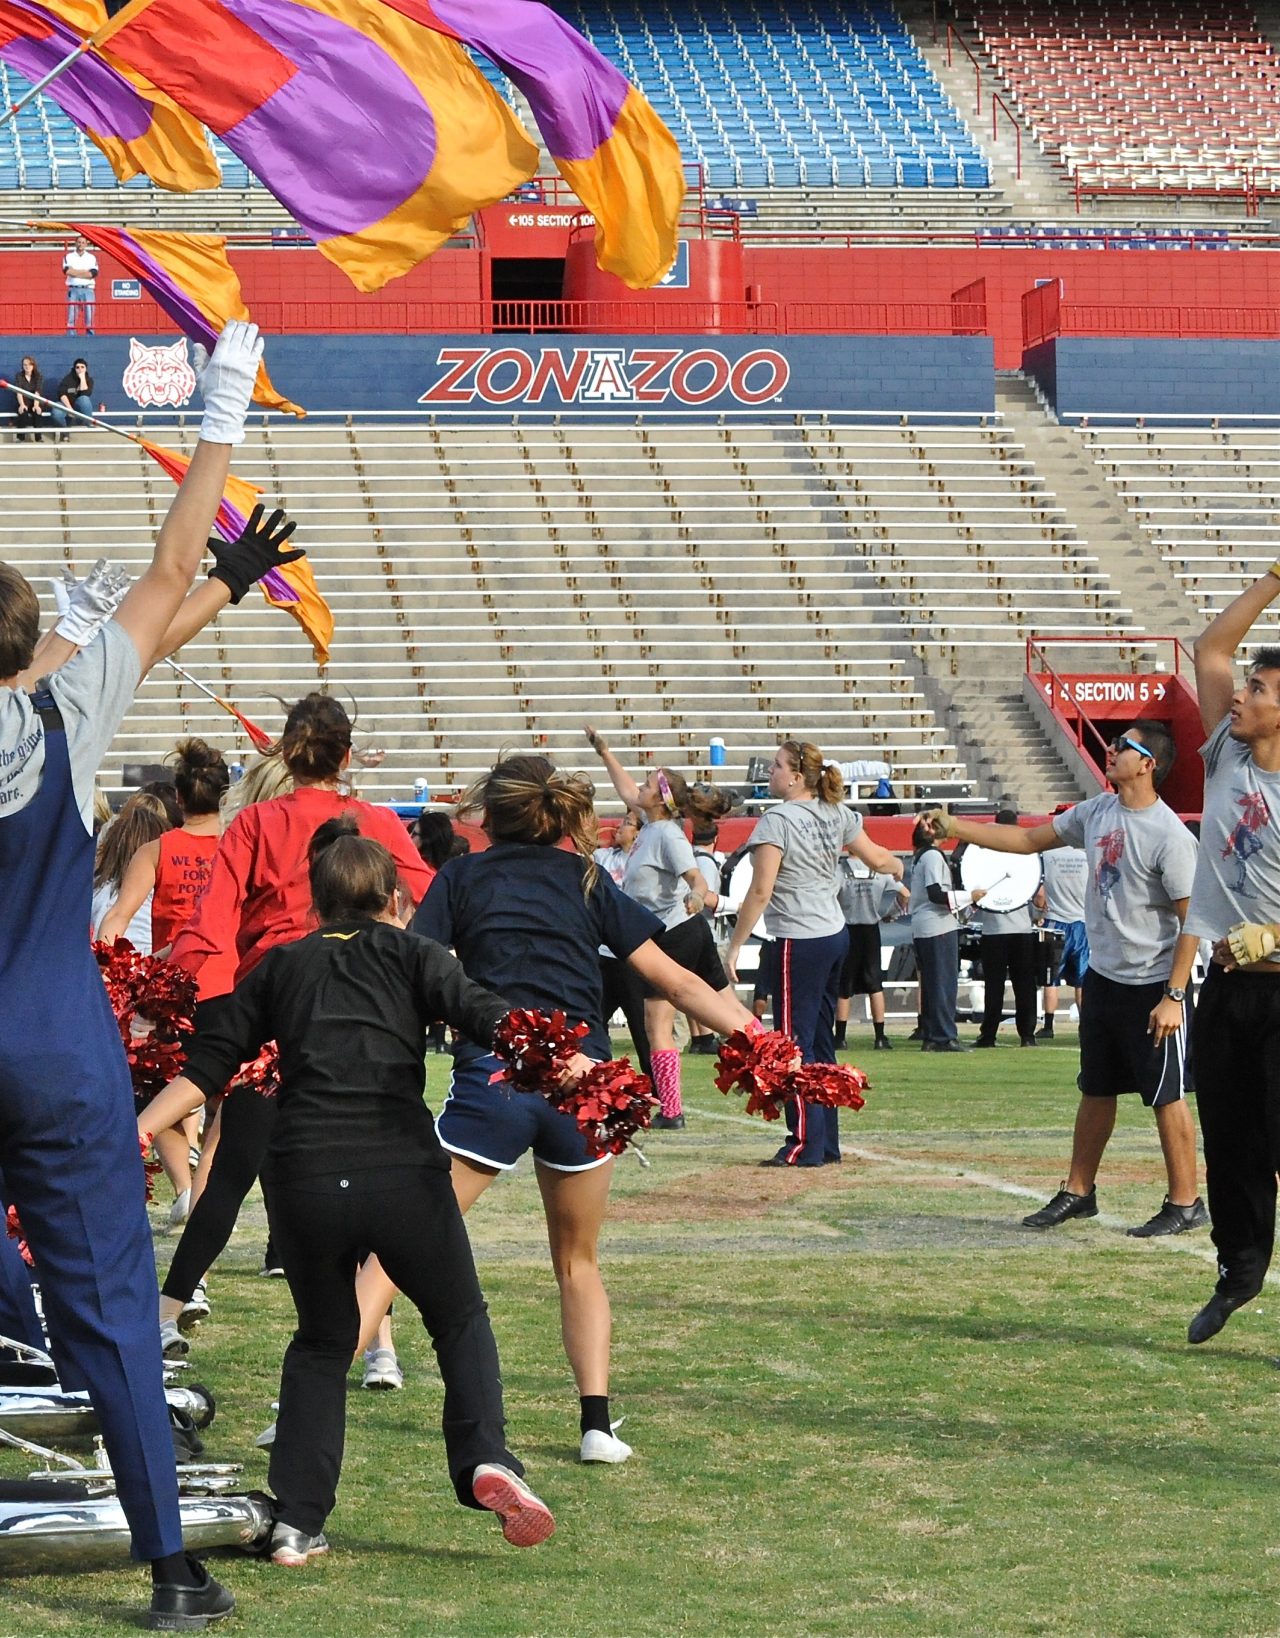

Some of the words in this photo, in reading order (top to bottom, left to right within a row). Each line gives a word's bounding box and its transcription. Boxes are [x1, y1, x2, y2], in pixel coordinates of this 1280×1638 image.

[518, 215, 534, 226] 105
[418, 347, 790, 406] ZONAZOO
[1075, 682, 1135, 702] SECTION
[1140, 682, 1149, 701] 5
[171, 855, 191, 867] WE
